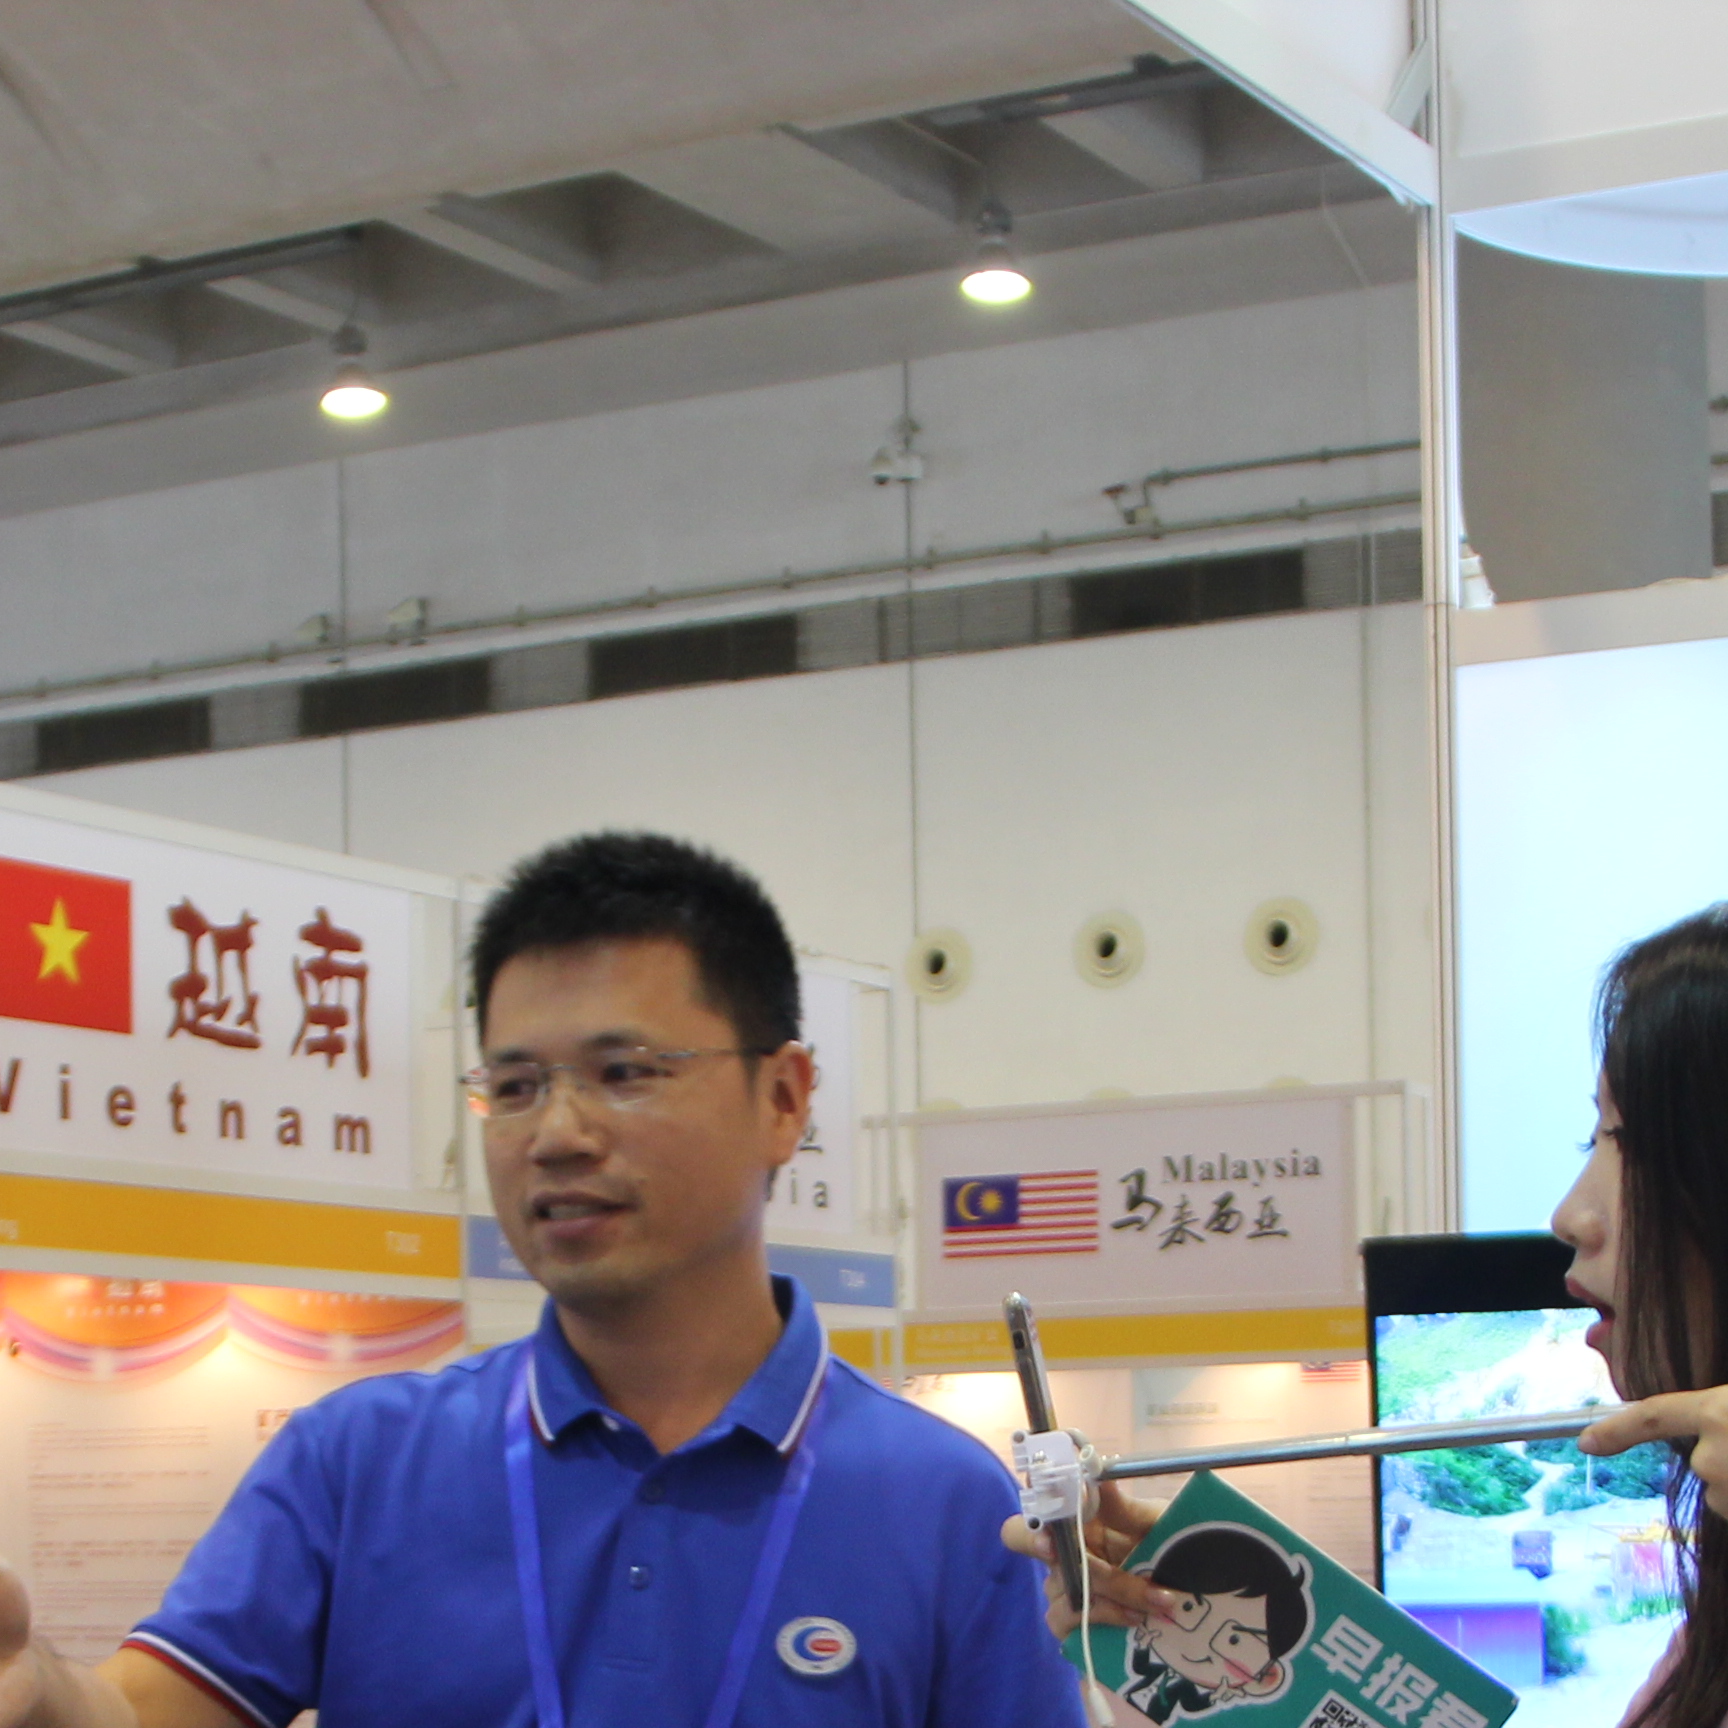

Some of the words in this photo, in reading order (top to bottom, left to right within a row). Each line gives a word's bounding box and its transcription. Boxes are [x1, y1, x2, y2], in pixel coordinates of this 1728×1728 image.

[167, 896, 370, 1078] 越南
[1110, 1167, 1291, 1250] 马来西亚
[1160, 1148, 1322, 1188] Malaysia
